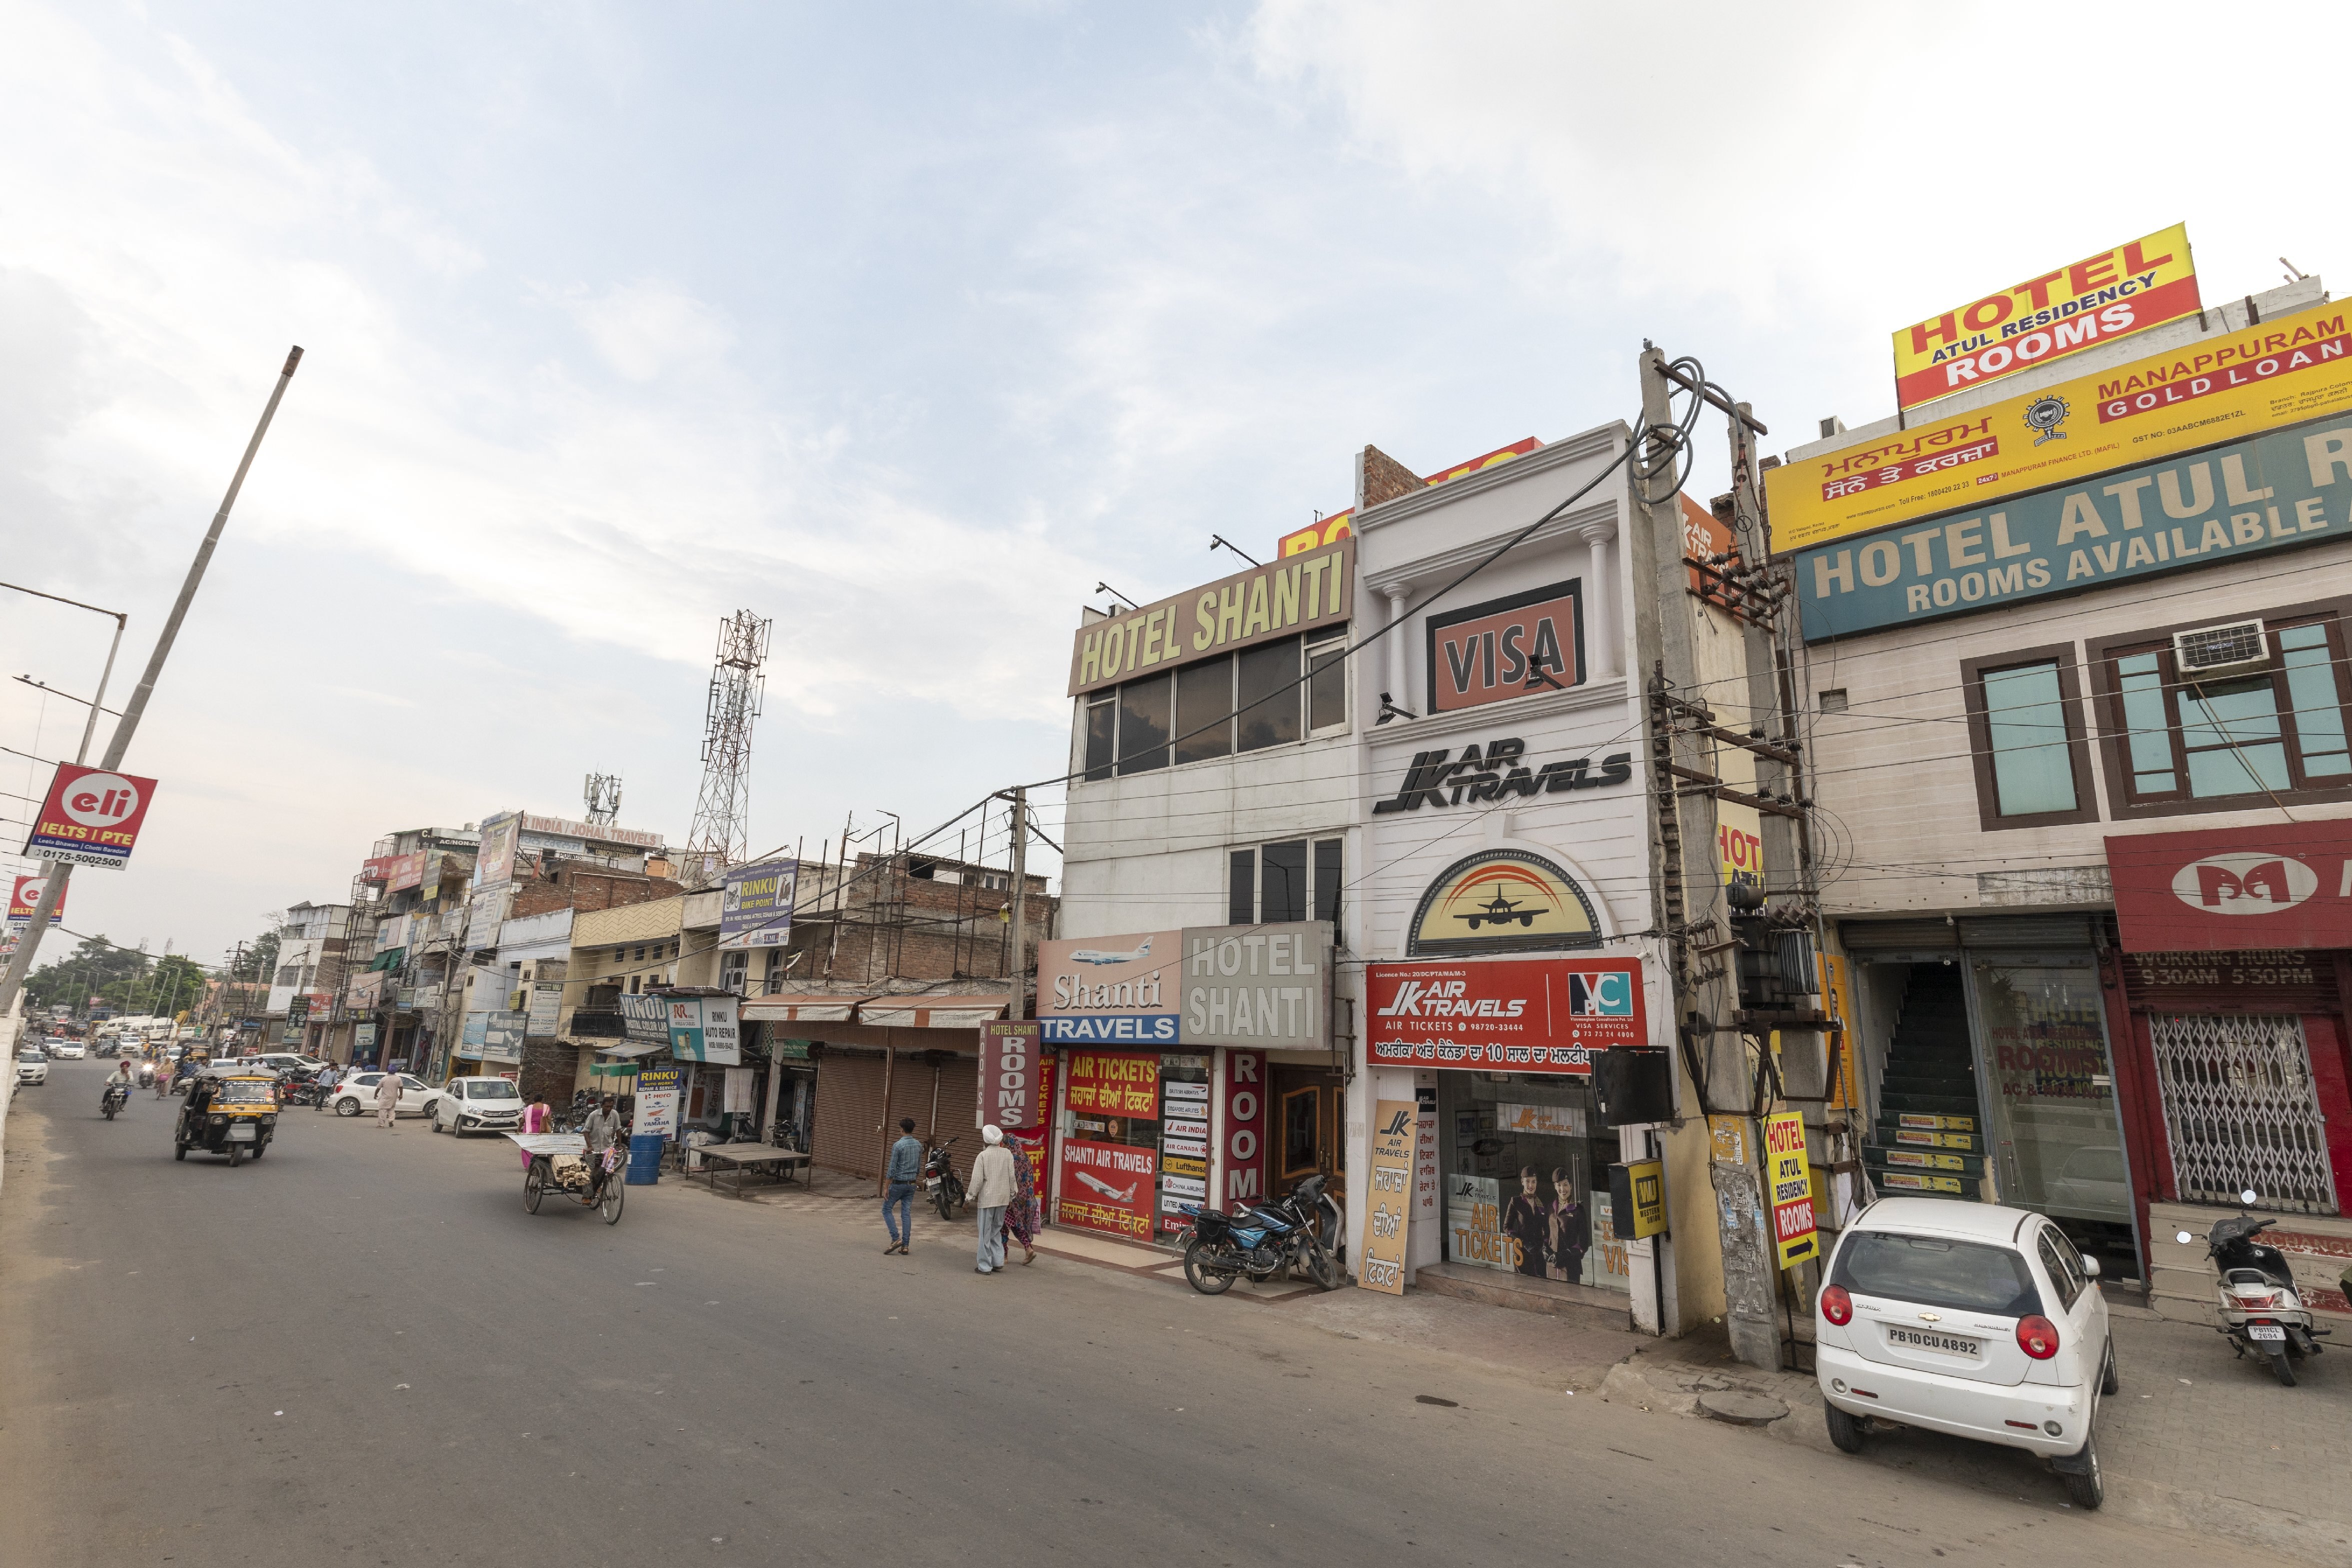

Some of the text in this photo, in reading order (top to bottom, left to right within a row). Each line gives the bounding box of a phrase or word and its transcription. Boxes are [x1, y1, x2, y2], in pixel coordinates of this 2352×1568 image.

[1911, 241, 2173, 356] HOTEL
[1931, 270, 2157, 364] ATUL RESIDENCY
[1946, 303, 2135, 387] ROOMS
[2098, 315, 2345, 399] MANAPPURAM
[2107, 340, 2344, 417] GOLD LOAN
[2301, 387, 2327, 396] Rajpura
[2133, 430, 2165, 444] GST NO:
[2001, 462, 2047, 478] MANAPPURAM
[2048, 454, 2077, 466] FINANCE
[2094, 442, 2120, 454] (MAFIL)
[1878, 466, 1902, 484] ਤੇ
[1898, 496, 1910, 506] Toll
[1910, 492, 1926, 503] Free:
[1927, 484, 1952, 498] 1800420
[1962, 480, 1969, 488] 33
[1813, 512, 2031, 600] HOTEL
[2056, 453, 2286, 546] ATUL
[1905, 496, 2326, 614] ROOMS AVAILABLE
[1079, 550, 1344, 686] HOTEL SHANTI
[1443, 616, 1565, 694] VISA
[1452, 736, 1525, 776] AIR
[1445, 752, 1631, 806] TRAVELS
[72, 789, 131, 818] eli
[41, 822, 134, 845] IELTS PTE
[56, 840, 79, 848] Bhawan
[531, 818, 562, 833] INDIA
[571, 824, 607, 840] JOHAL
[610, 829, 656, 846] TRAVELS
[43, 850, 122, 867] 0175-5002500
[559, 852, 582, 860] POUNDS
[741, 877, 777, 897] RINKU
[741, 898, 774, 910] BIKE POINT
[1192, 933, 1316, 977] HOTEL
[1054, 970, 1163, 1010] Shanti
[1425, 980, 1466, 998] AIR
[621, 997, 667, 1020] VINOD
[674, 1004, 688, 1018] RR
[712, 1012, 727, 1022] RINKU
[1188, 986, 1314, 1038] SHANTI
[1420, 999, 1527, 1017] TRAVELS
[626, 1019, 668, 1032] DIGITAL COLOR LAB
[705, 1026, 736, 1039] AUTO REPAIR
[991, 1024, 1038, 1036] HOTEL SHANTI
[1041, 1018, 1174, 1039] TRAVELS
[1385, 1021, 1524, 1032] AIR TICKETS 98720-33444
[1375, 1038, 1547, 1064] ਅਮਰੀਕਾ ਅਤੇ ਕੈਨੇਡਾ ਦਾ 10 ਸਾਲ ਦਾ
[1997, 1045, 2100, 1074] ROOMS
[641, 1071, 679, 1081] RINKU
[998, 1036, 1026, 1126] ROOMS
[1072, 1056, 1156, 1084] AIR TICKETS
[709, 1076, 721, 1108] Castrol
[1099, 1082, 1154, 1113] ਦੀਆਂ ਟਿਕਟਾਂ
[2003, 1082, 2022, 1096] AC
[1537, 1123, 1572, 1132] TRAVELS
[1767, 1120, 1804, 1155] HOTEL
[1065, 1144, 1153, 1175] SHANTI AIR TRAVELS
[1375, 1147, 1410, 1158] TRAVELS
[1176, 1162, 1206, 1173] Lufthansa
[1779, 1158, 1801, 1180] ATUL
[1776, 1178, 1808, 1202] RESIDENCY
[1164, 1200, 1177, 1208] UNITED
[1640, 1206, 1660, 1218] WESTERN
[1373, 1202, 1401, 1240] ਦੀਆਂ
[1471, 1202, 1498, 1233] AIR
[1647, 1215, 1660, 1224] UNION
[1779, 1202, 1813, 1236] ROOMS
[1455, 1228, 1524, 1267] TICKETS
[1364, 1248, 1400, 1287] ਟਿਕਟਾਂ
[1855, 1303, 1881, 1312] SPARK
[1973, 1323, 2011, 1332] CHEVROLET
